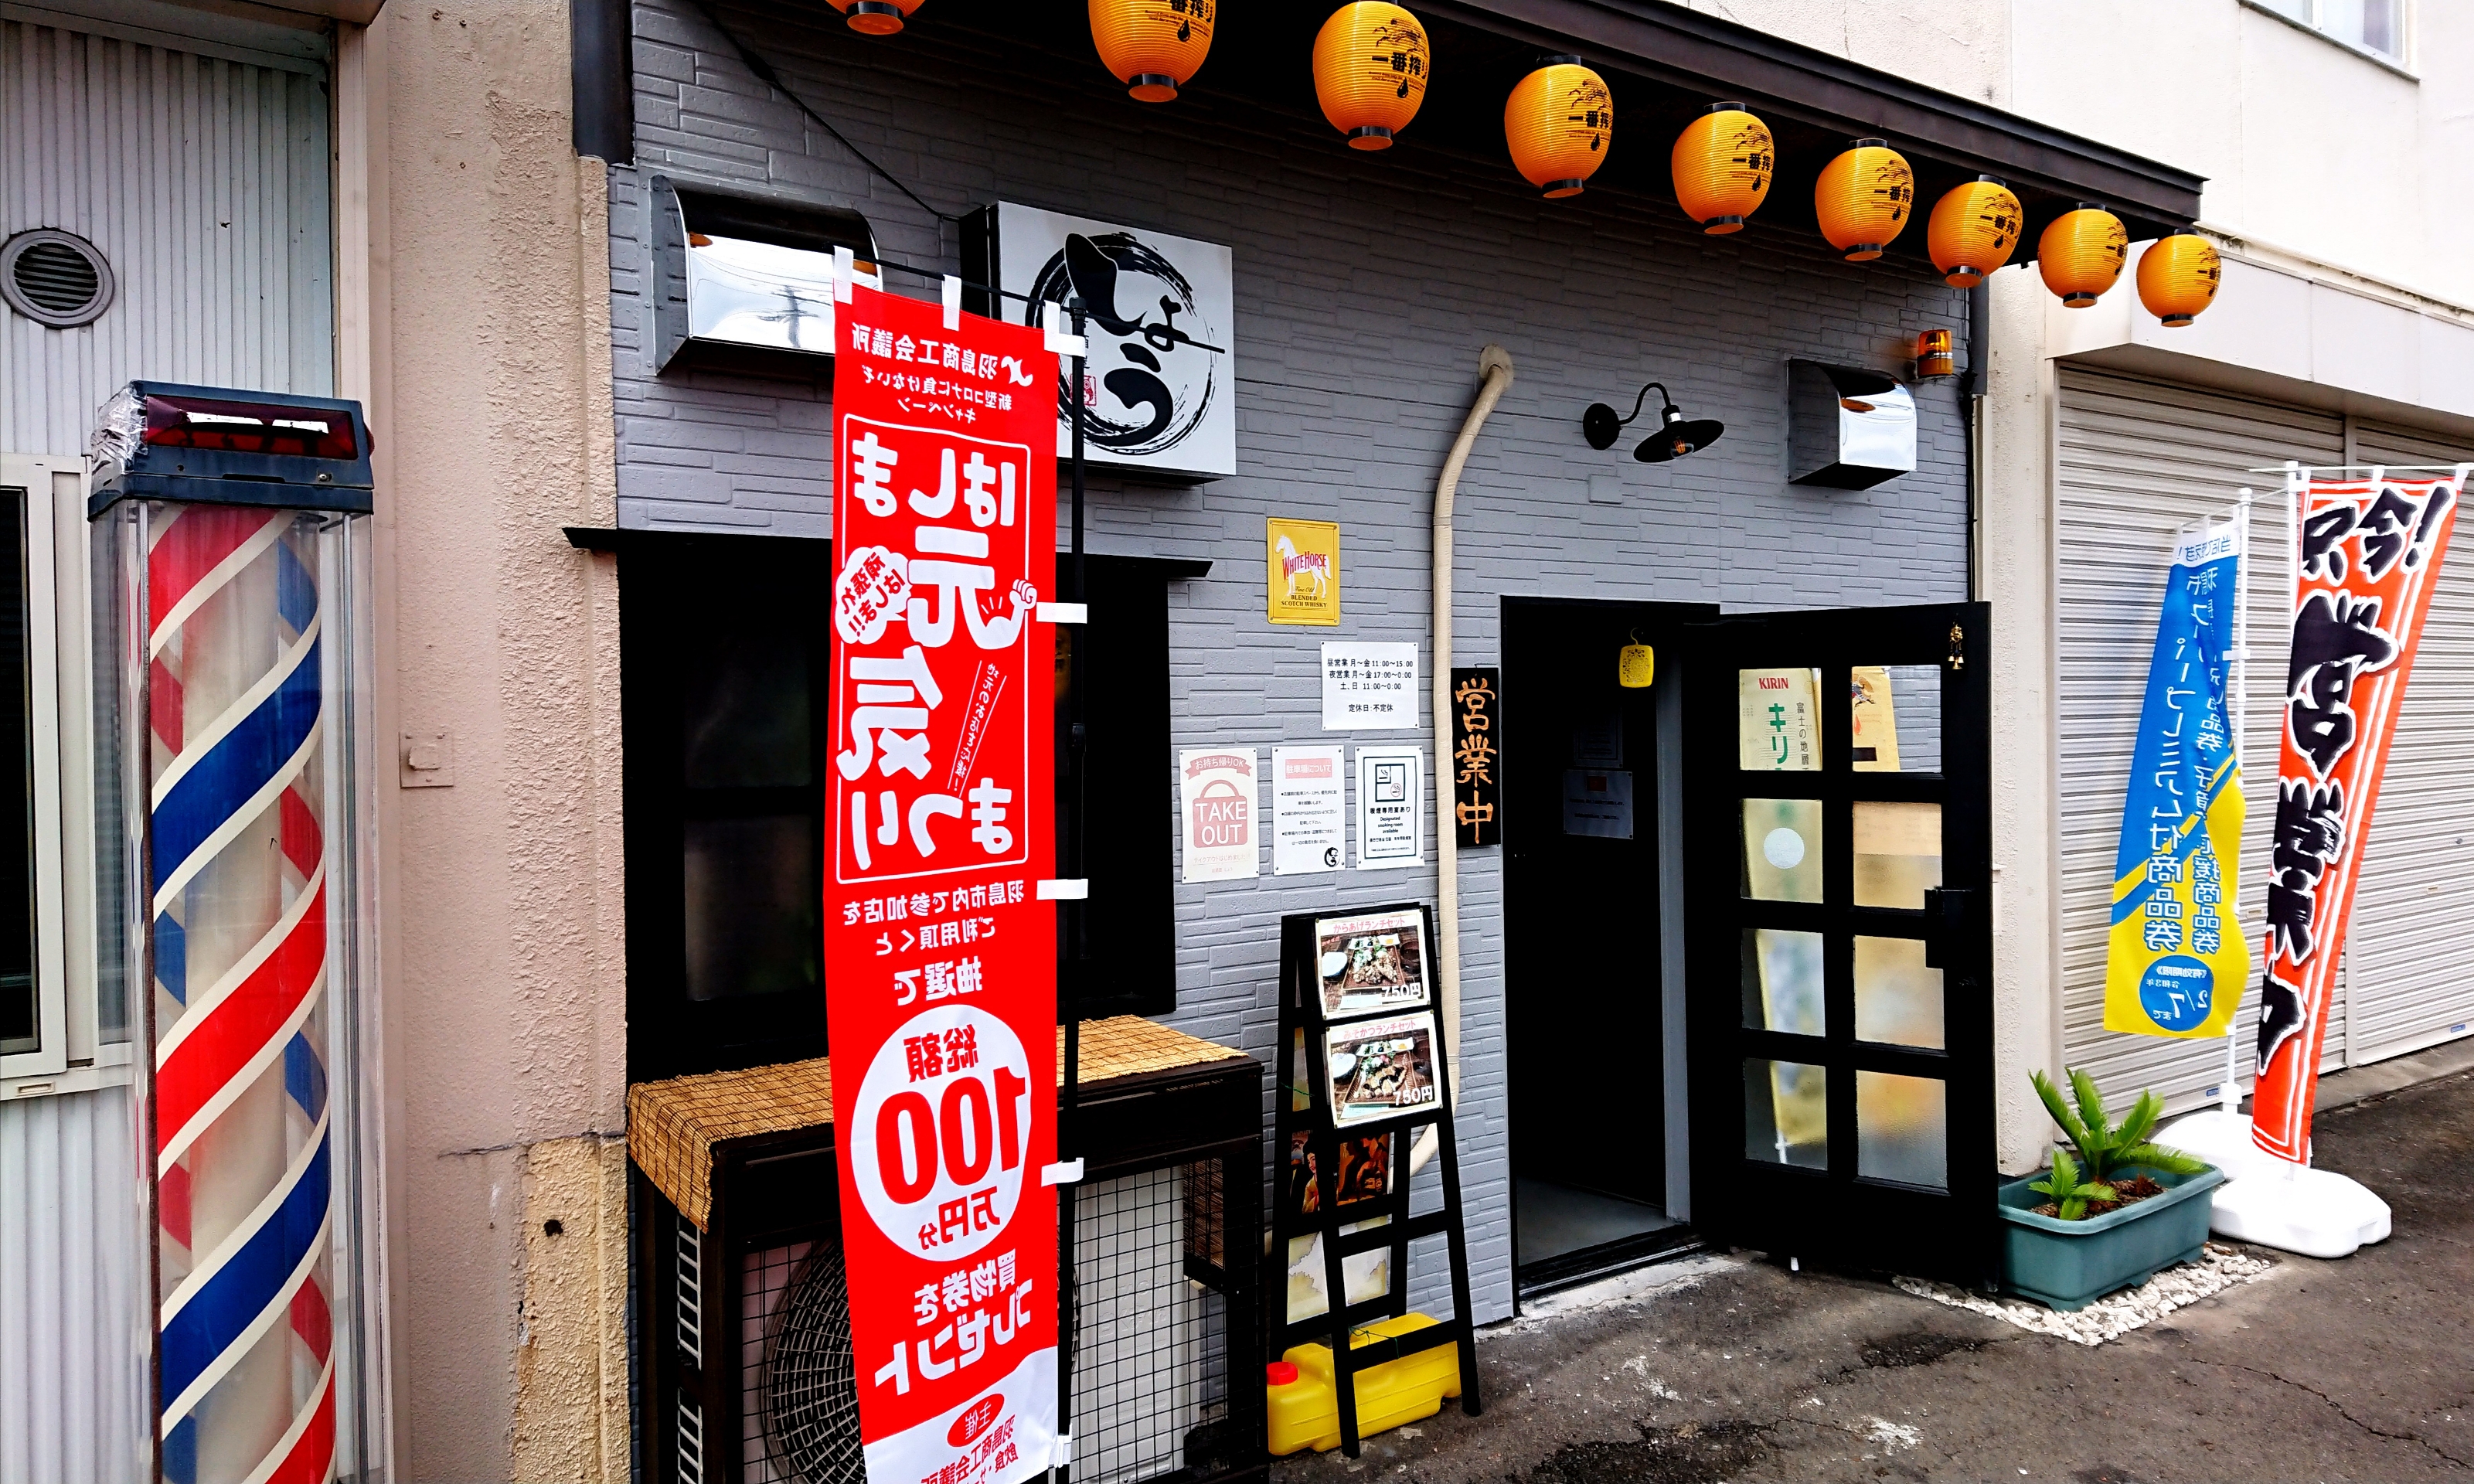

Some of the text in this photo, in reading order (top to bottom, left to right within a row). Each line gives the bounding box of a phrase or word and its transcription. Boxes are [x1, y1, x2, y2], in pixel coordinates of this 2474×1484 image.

[1282, 551, 1327, 581] WHITE HORSE
[1758, 677, 1789, 689] KIRIN
[1455, 678, 1497, 844] 営業中
[1195, 801, 1247, 822] TAKE
[1201, 824, 1242, 845] OUT
[1333, 917, 1405, 933] からあげランチセット
[1393, 1085, 1433, 1106] 750円
